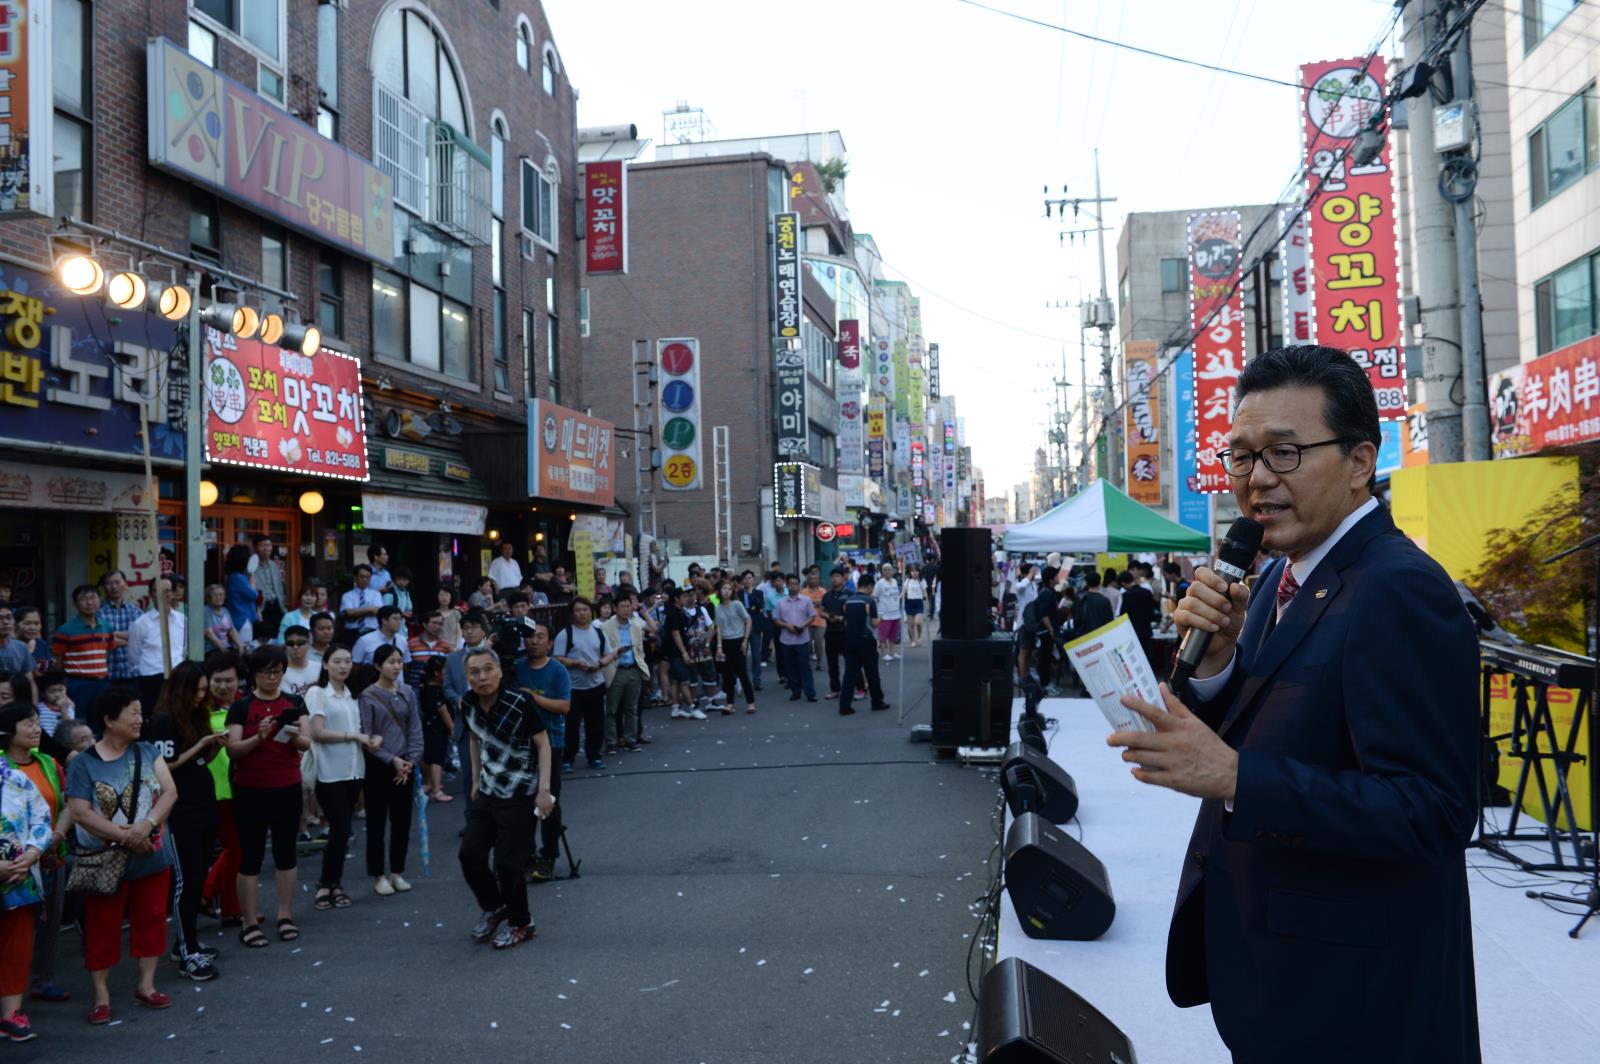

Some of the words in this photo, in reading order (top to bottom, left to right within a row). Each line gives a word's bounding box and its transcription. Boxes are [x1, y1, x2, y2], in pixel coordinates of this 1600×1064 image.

[228, 93, 325, 209] VIP
[592, 186, 618, 235] 맛꼬치
[1320, 192, 1384, 342] 양꼬치
[247, 366, 279, 397] 꼬치
[1523, 357, 1600, 424] 羊肉串
[257, 399, 289, 430] 꼬치
[283, 376, 361, 437] 맛꼬치
[781, 389, 803, 435] 야미
[212, 431, 241, 452] 양꼬치
[242, 435, 269, 459] 전문점
[325, 450, 361, 469] 821-5188
[668, 462, 692, 479] 2층
